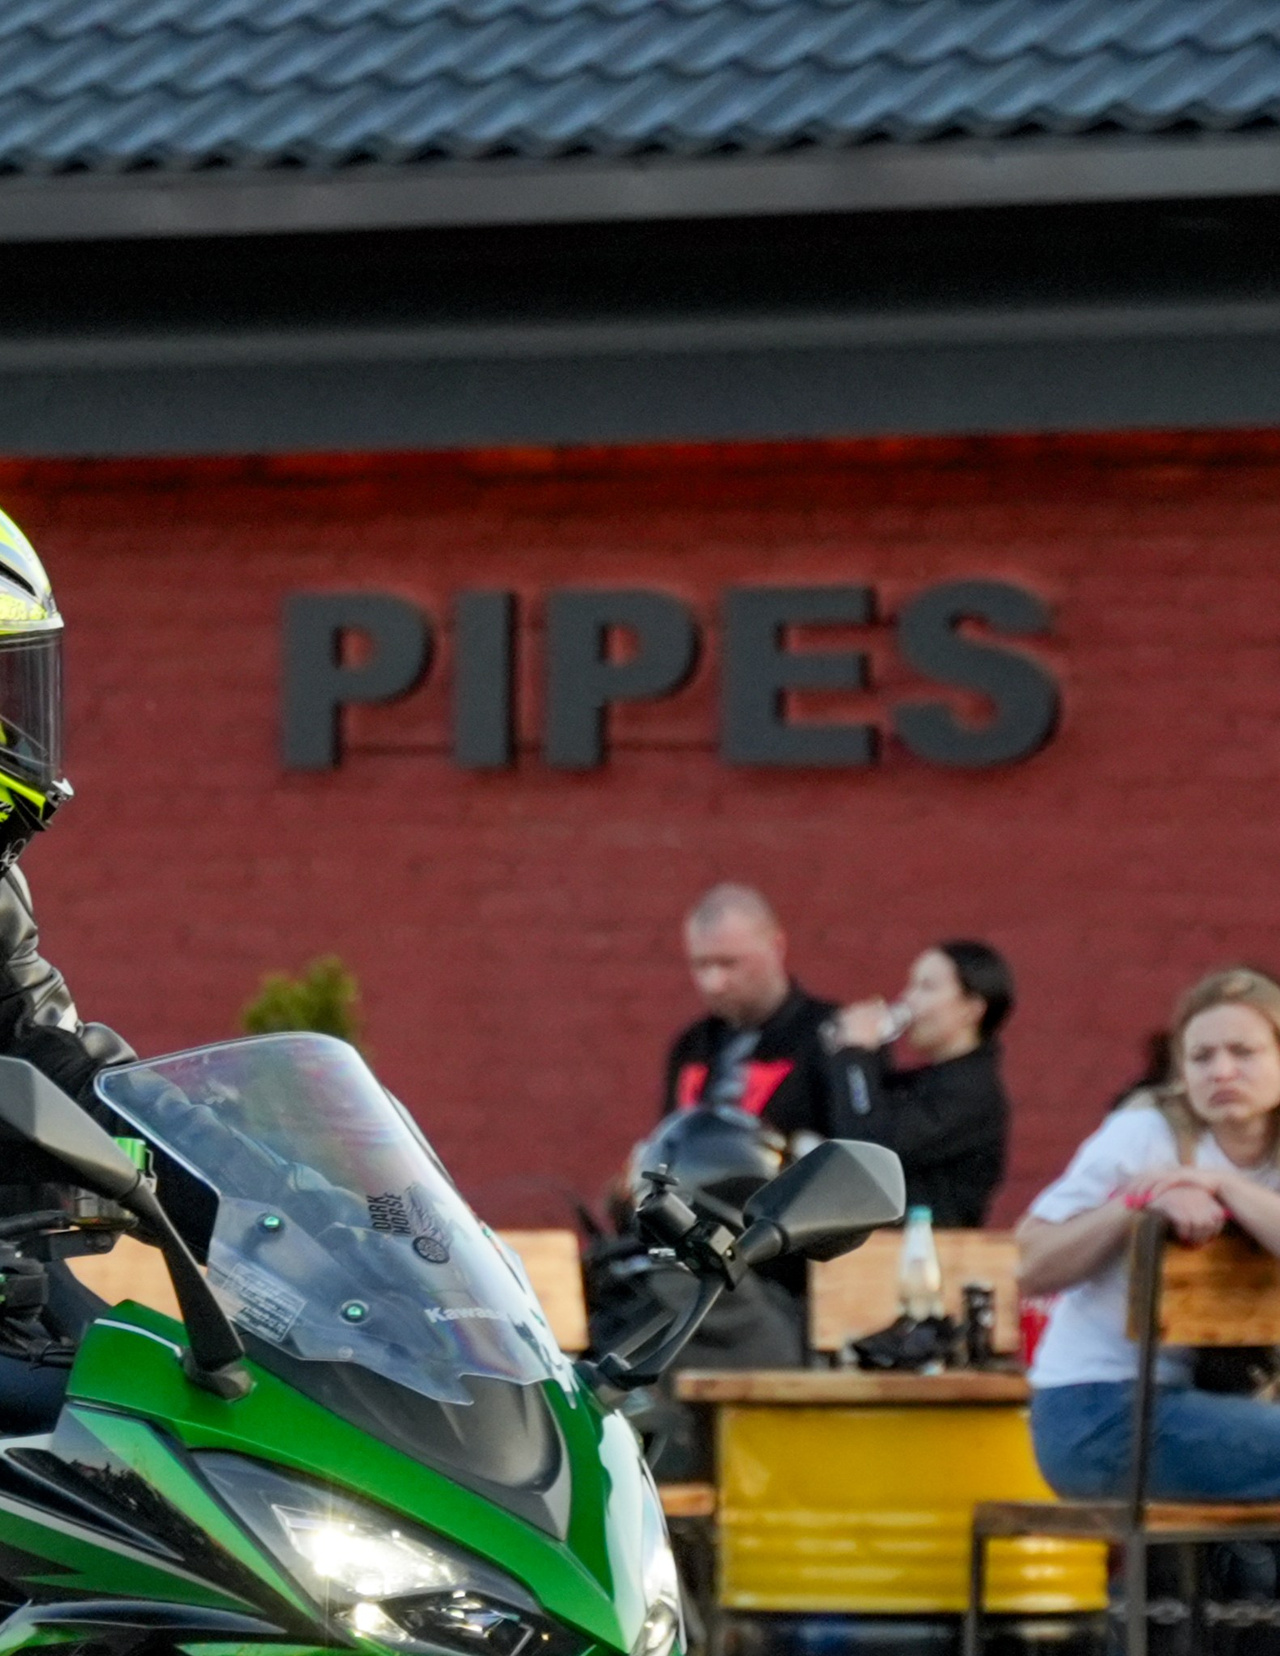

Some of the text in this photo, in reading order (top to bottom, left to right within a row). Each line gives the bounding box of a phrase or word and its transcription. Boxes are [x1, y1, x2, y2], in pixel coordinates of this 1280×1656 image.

[281, 579, 1061, 770] PIPES
[367, 1195, 391, 1229] DARK
[384, 1192, 411, 1234] HORSE
